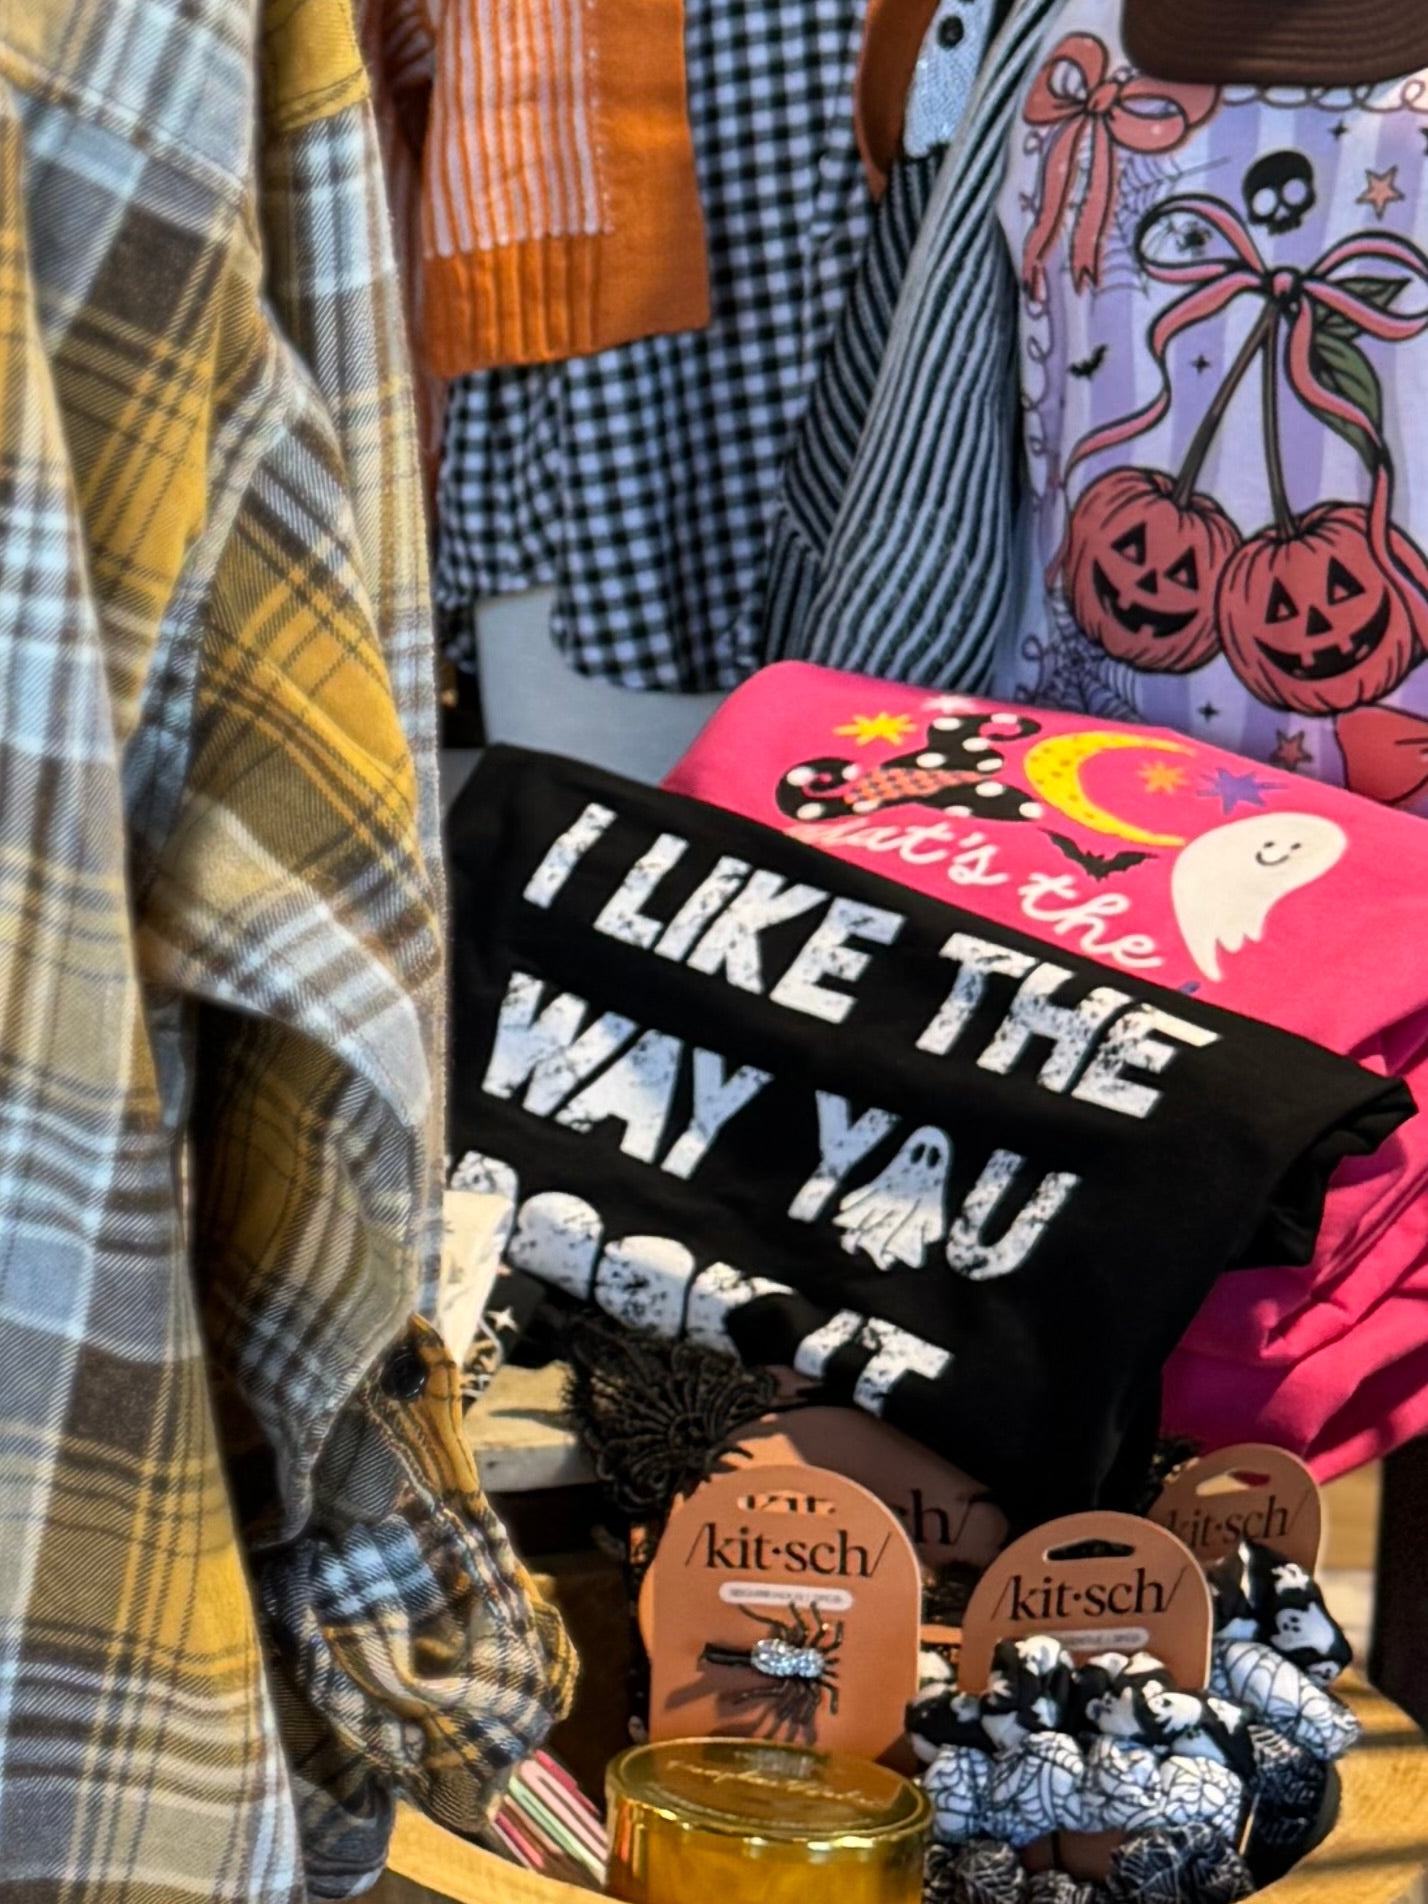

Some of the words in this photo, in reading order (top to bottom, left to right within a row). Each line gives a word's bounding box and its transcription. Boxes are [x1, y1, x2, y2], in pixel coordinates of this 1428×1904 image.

[521, 801, 618, 911] I
[592, 832, 907, 1025] LIKE
[914, 930, 1223, 1120] THE
[1018, 869, 1165, 971] the
[480, 970, 775, 1181] WAY
